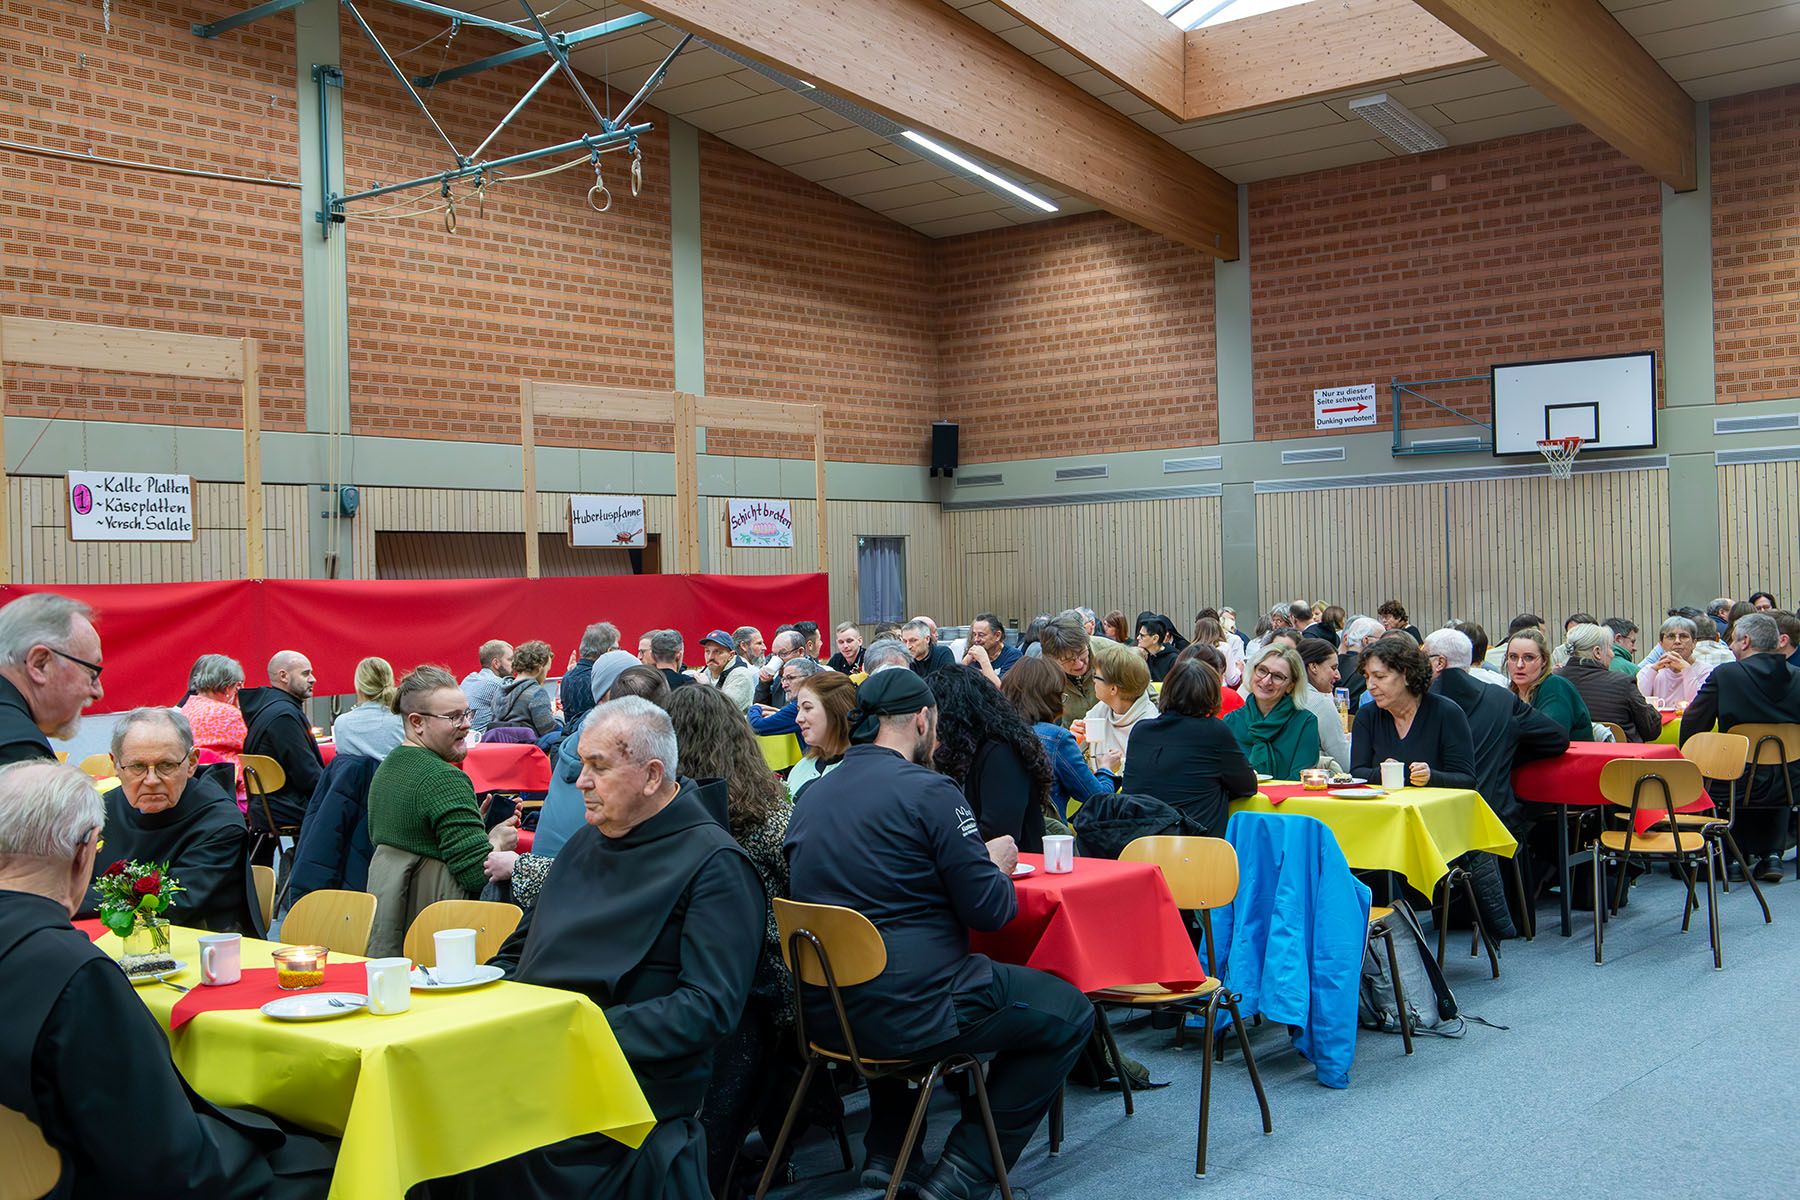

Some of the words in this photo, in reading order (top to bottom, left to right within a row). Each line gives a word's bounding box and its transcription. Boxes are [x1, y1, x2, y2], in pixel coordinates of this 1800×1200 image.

[1335, 394, 1373, 403] schwenken
[1316, 417, 1343, 426] Dunking
[1344, 414, 1374, 422] verboten!
[144, 476, 189, 494] Platten
[573, 505, 641, 524] Hubertuspfanne
